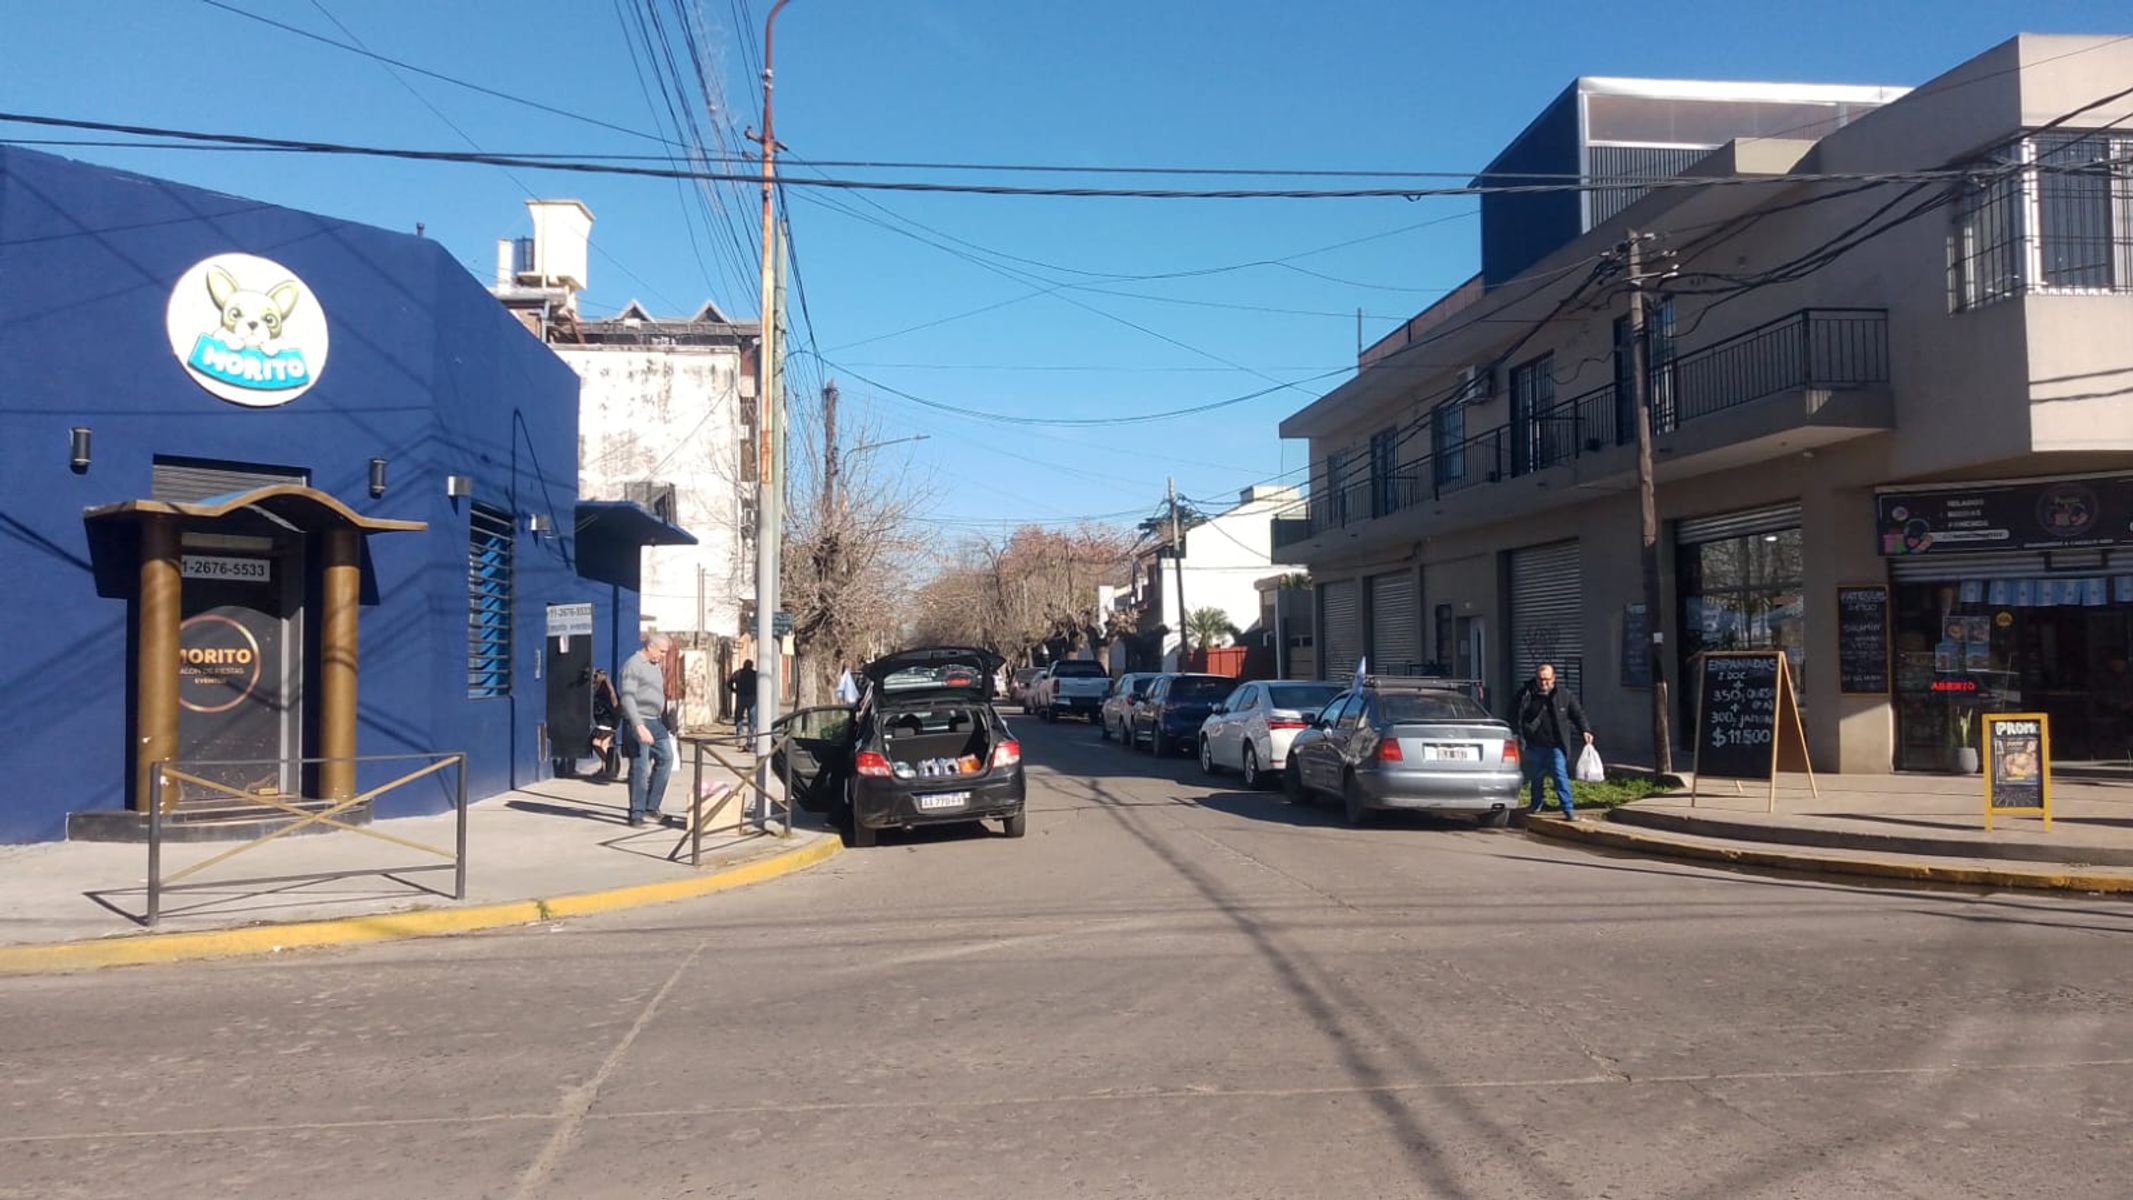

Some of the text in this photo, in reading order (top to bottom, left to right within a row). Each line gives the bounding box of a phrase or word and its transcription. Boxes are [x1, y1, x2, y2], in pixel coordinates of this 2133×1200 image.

[203, 345, 306, 381] MORITO
[182, 560, 265, 577] 1-2676-5533
[1707, 658, 1777, 671] EMPANADAS
